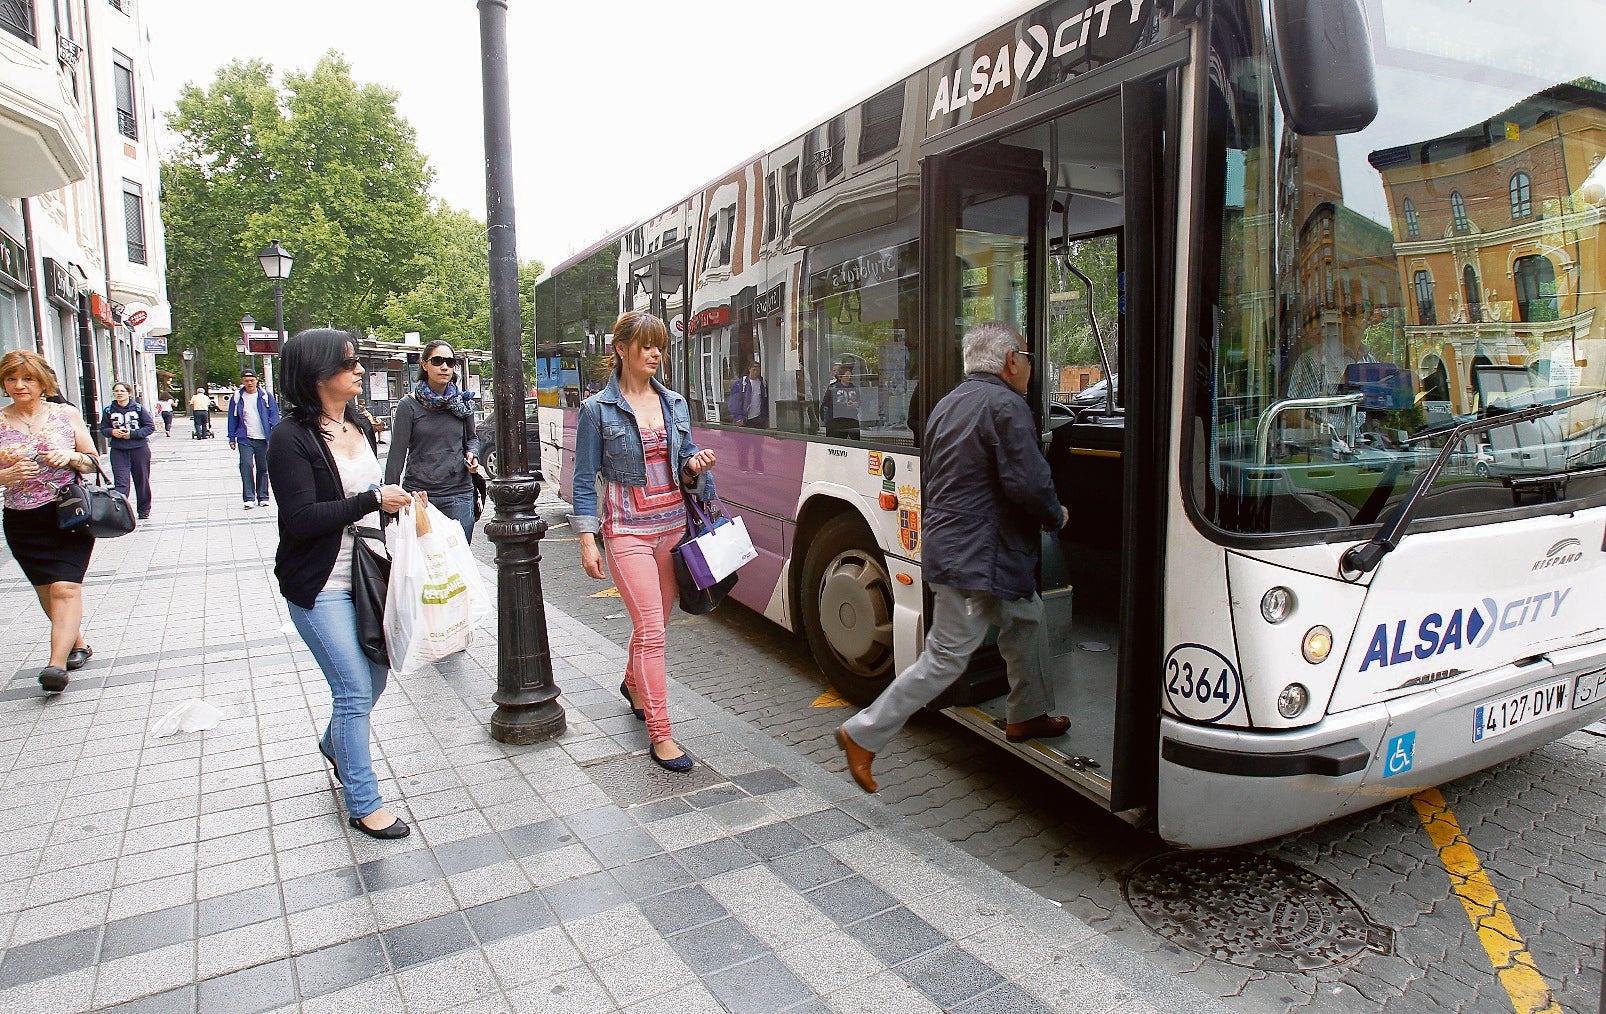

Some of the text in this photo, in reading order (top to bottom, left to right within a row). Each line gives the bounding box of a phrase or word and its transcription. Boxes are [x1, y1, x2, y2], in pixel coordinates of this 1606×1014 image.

[929, 44, 1010, 121] ALSA
[1532, 552, 1582, 571] HISPANO
[1359, 608, 1462, 672] ALSA
[1168, 658, 1229, 704] 2364
[1486, 684, 1566, 731] 4127 DVW
